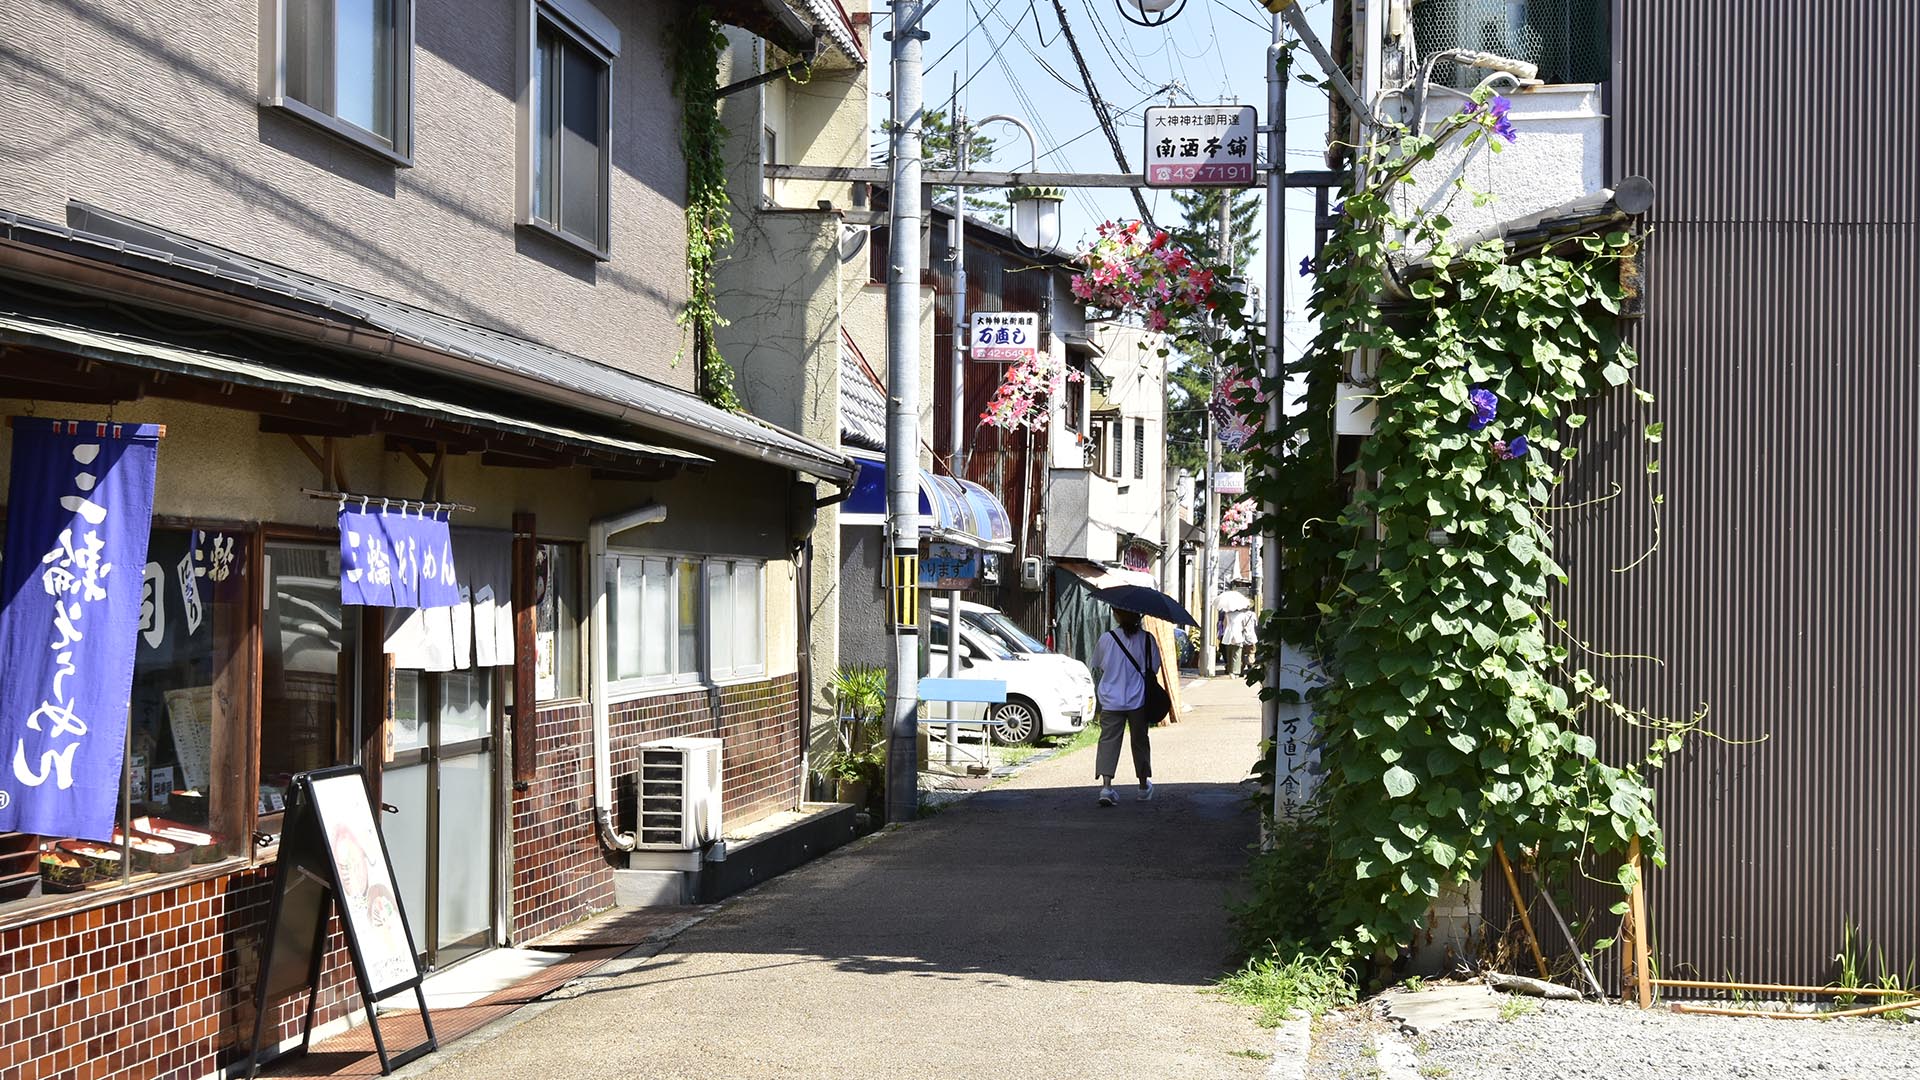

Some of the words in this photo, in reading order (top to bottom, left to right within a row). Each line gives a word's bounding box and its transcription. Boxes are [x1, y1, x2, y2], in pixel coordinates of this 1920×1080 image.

[1155, 114, 1240, 127] 大神神社御用達
[979, 327, 1026, 345] 万直し
[346, 531, 457, 592] 三輪そうめん
[1280, 717, 1300, 819] 万直し食堂
